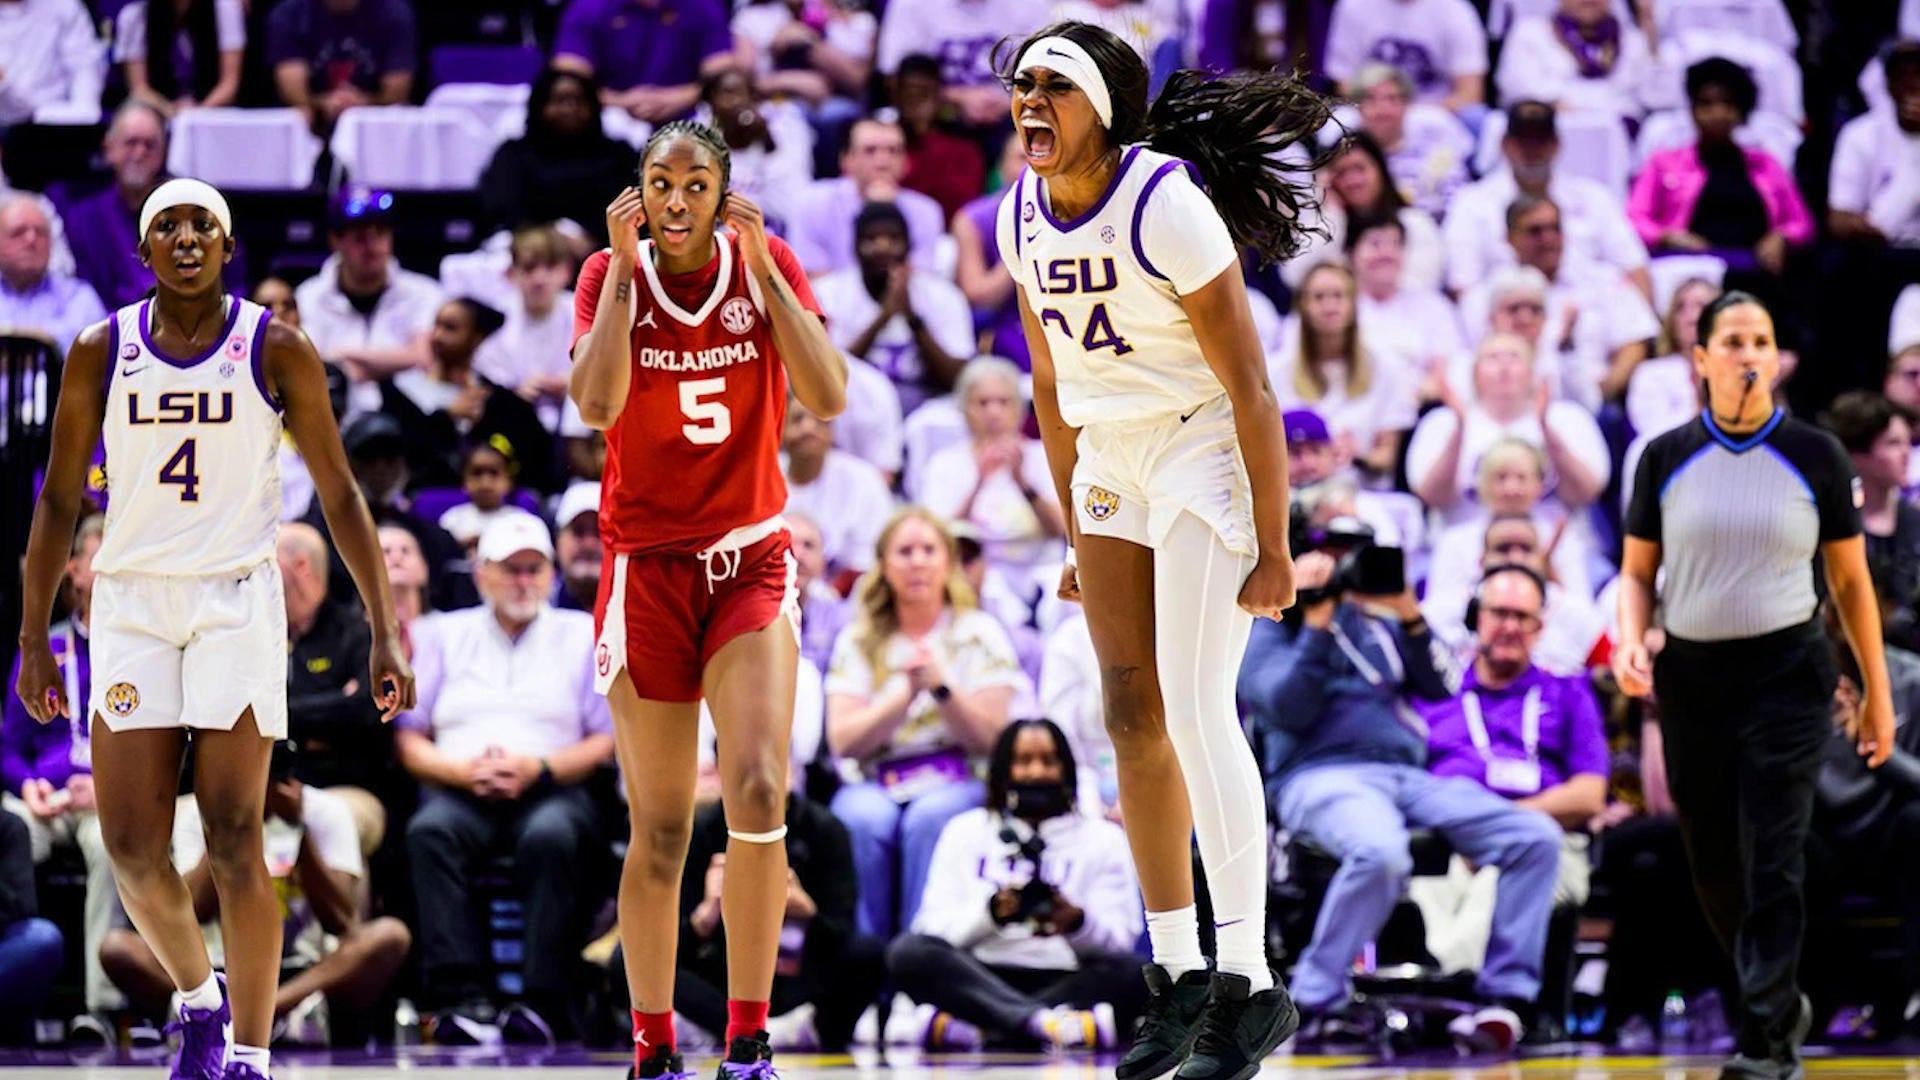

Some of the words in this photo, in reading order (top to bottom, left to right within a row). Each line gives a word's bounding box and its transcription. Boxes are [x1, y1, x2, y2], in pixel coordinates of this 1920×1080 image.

[722, 299, 754, 332] SEC
[640, 341, 759, 372] OKLAHOMA
[128, 392, 233, 425] LSU
[678, 376, 732, 445] 5
[159, 438, 200, 502] 4
